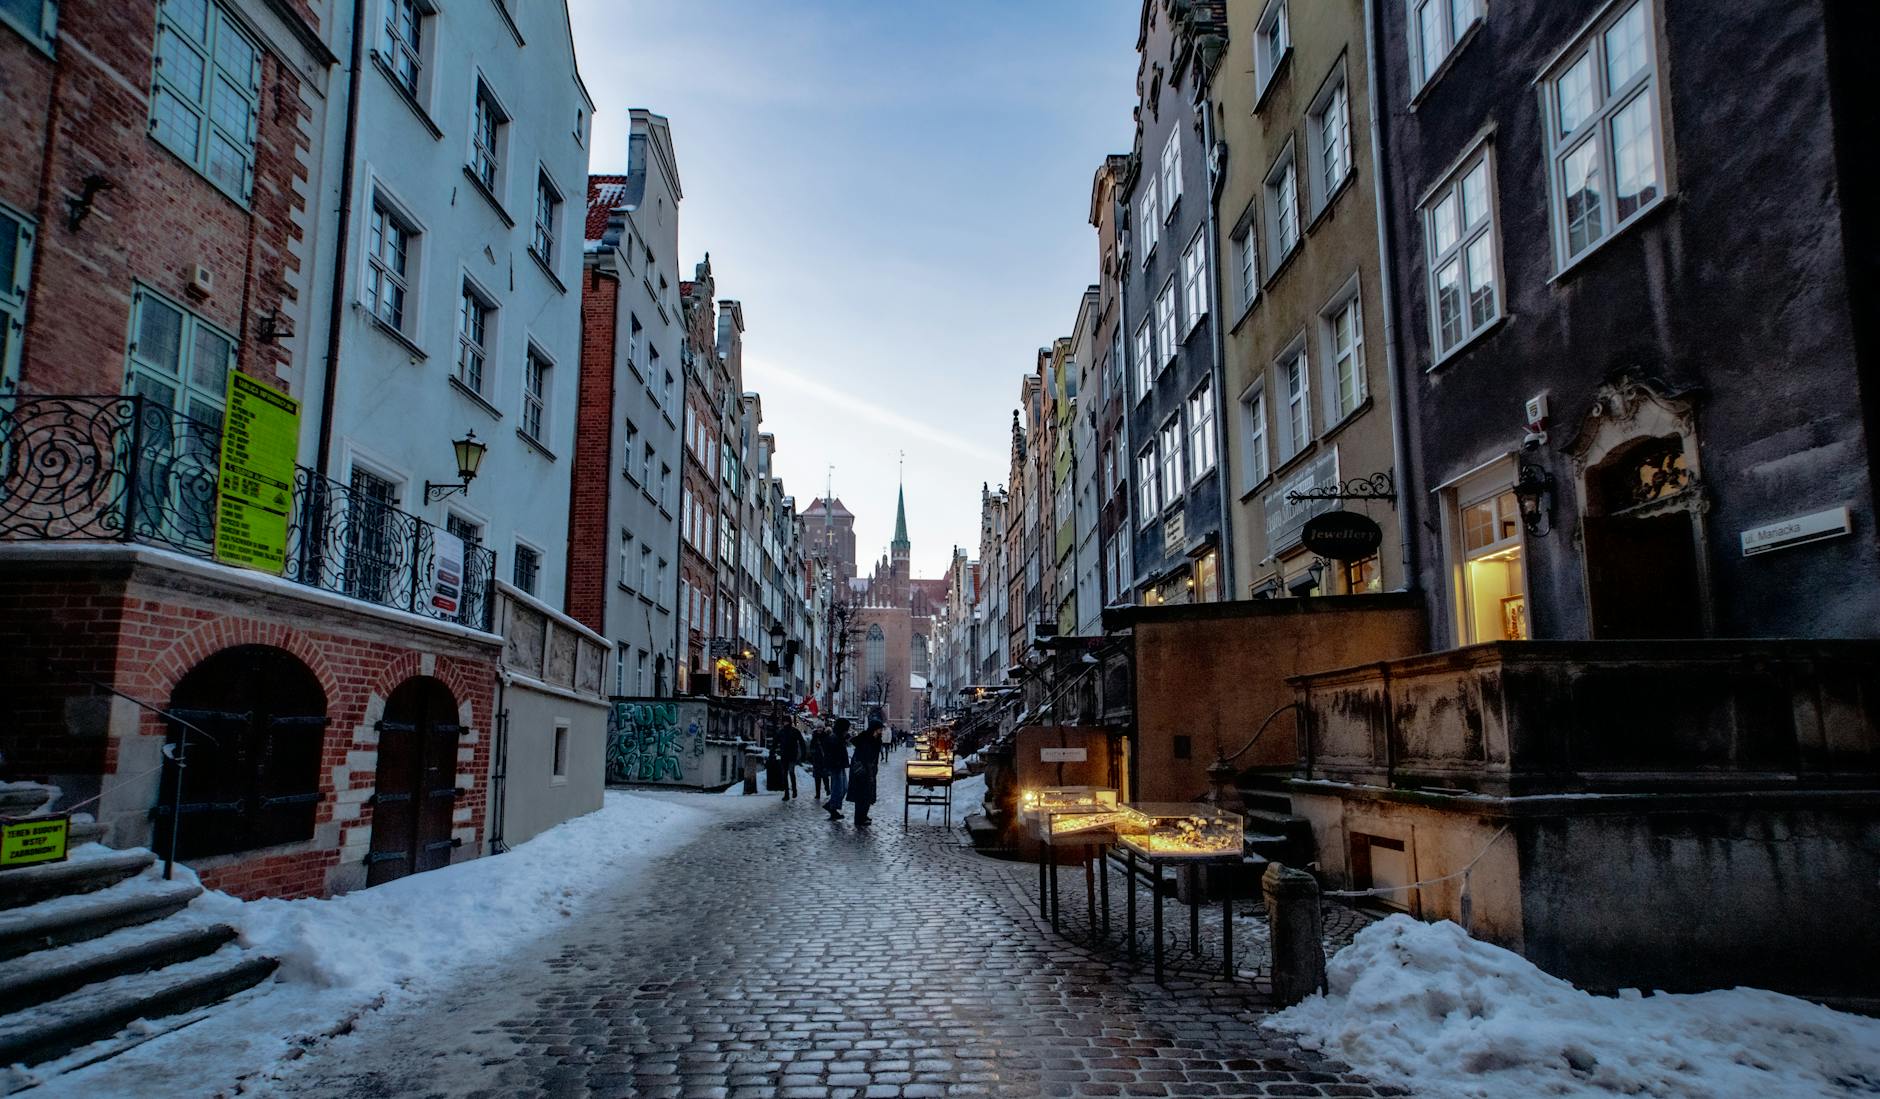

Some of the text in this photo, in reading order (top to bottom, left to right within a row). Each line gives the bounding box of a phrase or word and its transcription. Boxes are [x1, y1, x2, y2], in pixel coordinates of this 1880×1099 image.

[1311, 528, 1376, 542] Jewellery
[1758, 522, 1801, 540] Mariacka
[617, 702, 677, 729] FUN
[8, 825, 63, 838] TEREN BUDOWY
